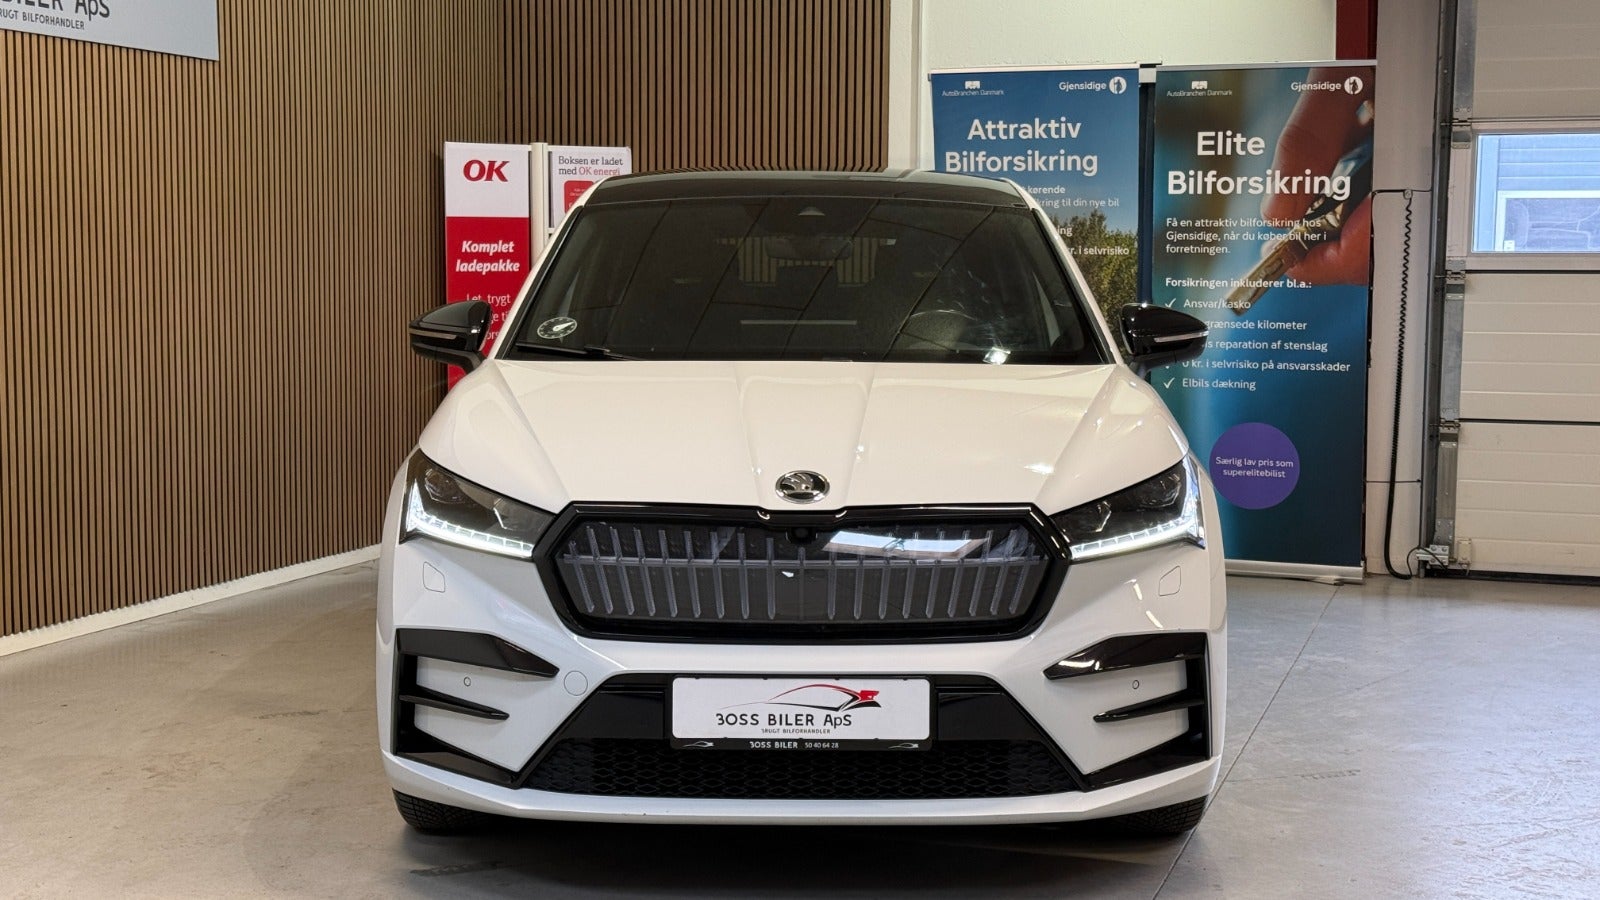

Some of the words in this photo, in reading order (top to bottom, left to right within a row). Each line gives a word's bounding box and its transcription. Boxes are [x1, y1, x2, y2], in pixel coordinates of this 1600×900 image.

[22, 12, 85, 30] BILFORHANDLER
[1058, 80, 1107, 92] Gjensidige
[1290, 80, 1342, 92] Gjensidige
[1166, 89, 1206, 97] AutoBranchen
[967, 116, 1082, 140] Attraktiv
[1196, 130, 1266, 156] Elite
[558, 155, 589, 166] Boksen
[590, 158, 600, 166] er
[601, 156, 624, 166] ladet
[945, 149, 1098, 177] Bilforsikring
[463, 159, 510, 182] OK
[558, 166, 577, 175] med
[578, 167, 592, 175] OK
[593, 167, 620, 177] energi
[1027, 185, 1066, 195] kørende
[1167, 169, 1351, 201] Bilforsikring
[1061, 198, 1071, 207] til
[1073, 198, 1088, 207] din
[1089, 199, 1106, 209] nye
[1108, 197, 1120, 207] bil
[1166, 217, 1178, 228] Få
[1180, 220, 1193, 228] en
[1194, 217, 1238, 228] attraktiv
[1239, 217, 1300, 230] bilforsikring
[1302, 217, 1322, 228] hos
[1166, 231, 1221, 242] Gjensidige,
[1223, 231, 1240, 241] når
[1241, 231, 1255, 241] du
[1257, 231, 1286, 241] køber
[1288, 231, 1302, 241] bil
[1303, 231, 1322, 241] her
[461, 240, 515, 256] Komplet
[1083, 245, 1130, 256] selvrisiko
[1165, 244, 1231, 256] forretningen.
[455, 259, 520, 275] ladepakke
[1165, 277, 1228, 289] Forsikringen
[1230, 277, 1285, 289] inkluderer
[1286, 278, 1312, 289] bl.a.:
[487, 294, 511, 306] trygt
[1183, 298, 1251, 309] Ansvar/kasko
[1205, 320, 1255, 330] grænsede
[1257, 319, 1307, 331] kilometer
[1215, 340, 1269, 352] reparation
[1270, 340, 1281, 350] af
[1283, 341, 1328, 352] stenslag
[1212, 359, 1259, 369] selvrisiko
[1261, 360, 1274, 371] på
[1276, 361, 1351, 372] ansvarsskader
[1182, 378, 1210, 388] Elbils
[1212, 379, 1256, 391] dækning
[1215, 456, 1242, 467] Særlig
[1243, 457, 1256, 466] lav
[1258, 458, 1274, 469] pris
[1275, 460, 1294, 468] som
[1222, 468, 1286, 479] superelitebilist
[768, 713, 815, 726] BILER
[823, 713, 852, 729] ApS
[774, 741, 798, 749] BILER
[814, 741, 822, 749] 40
[822, 741, 831, 749] 64
[831, 741, 839, 749] 28
